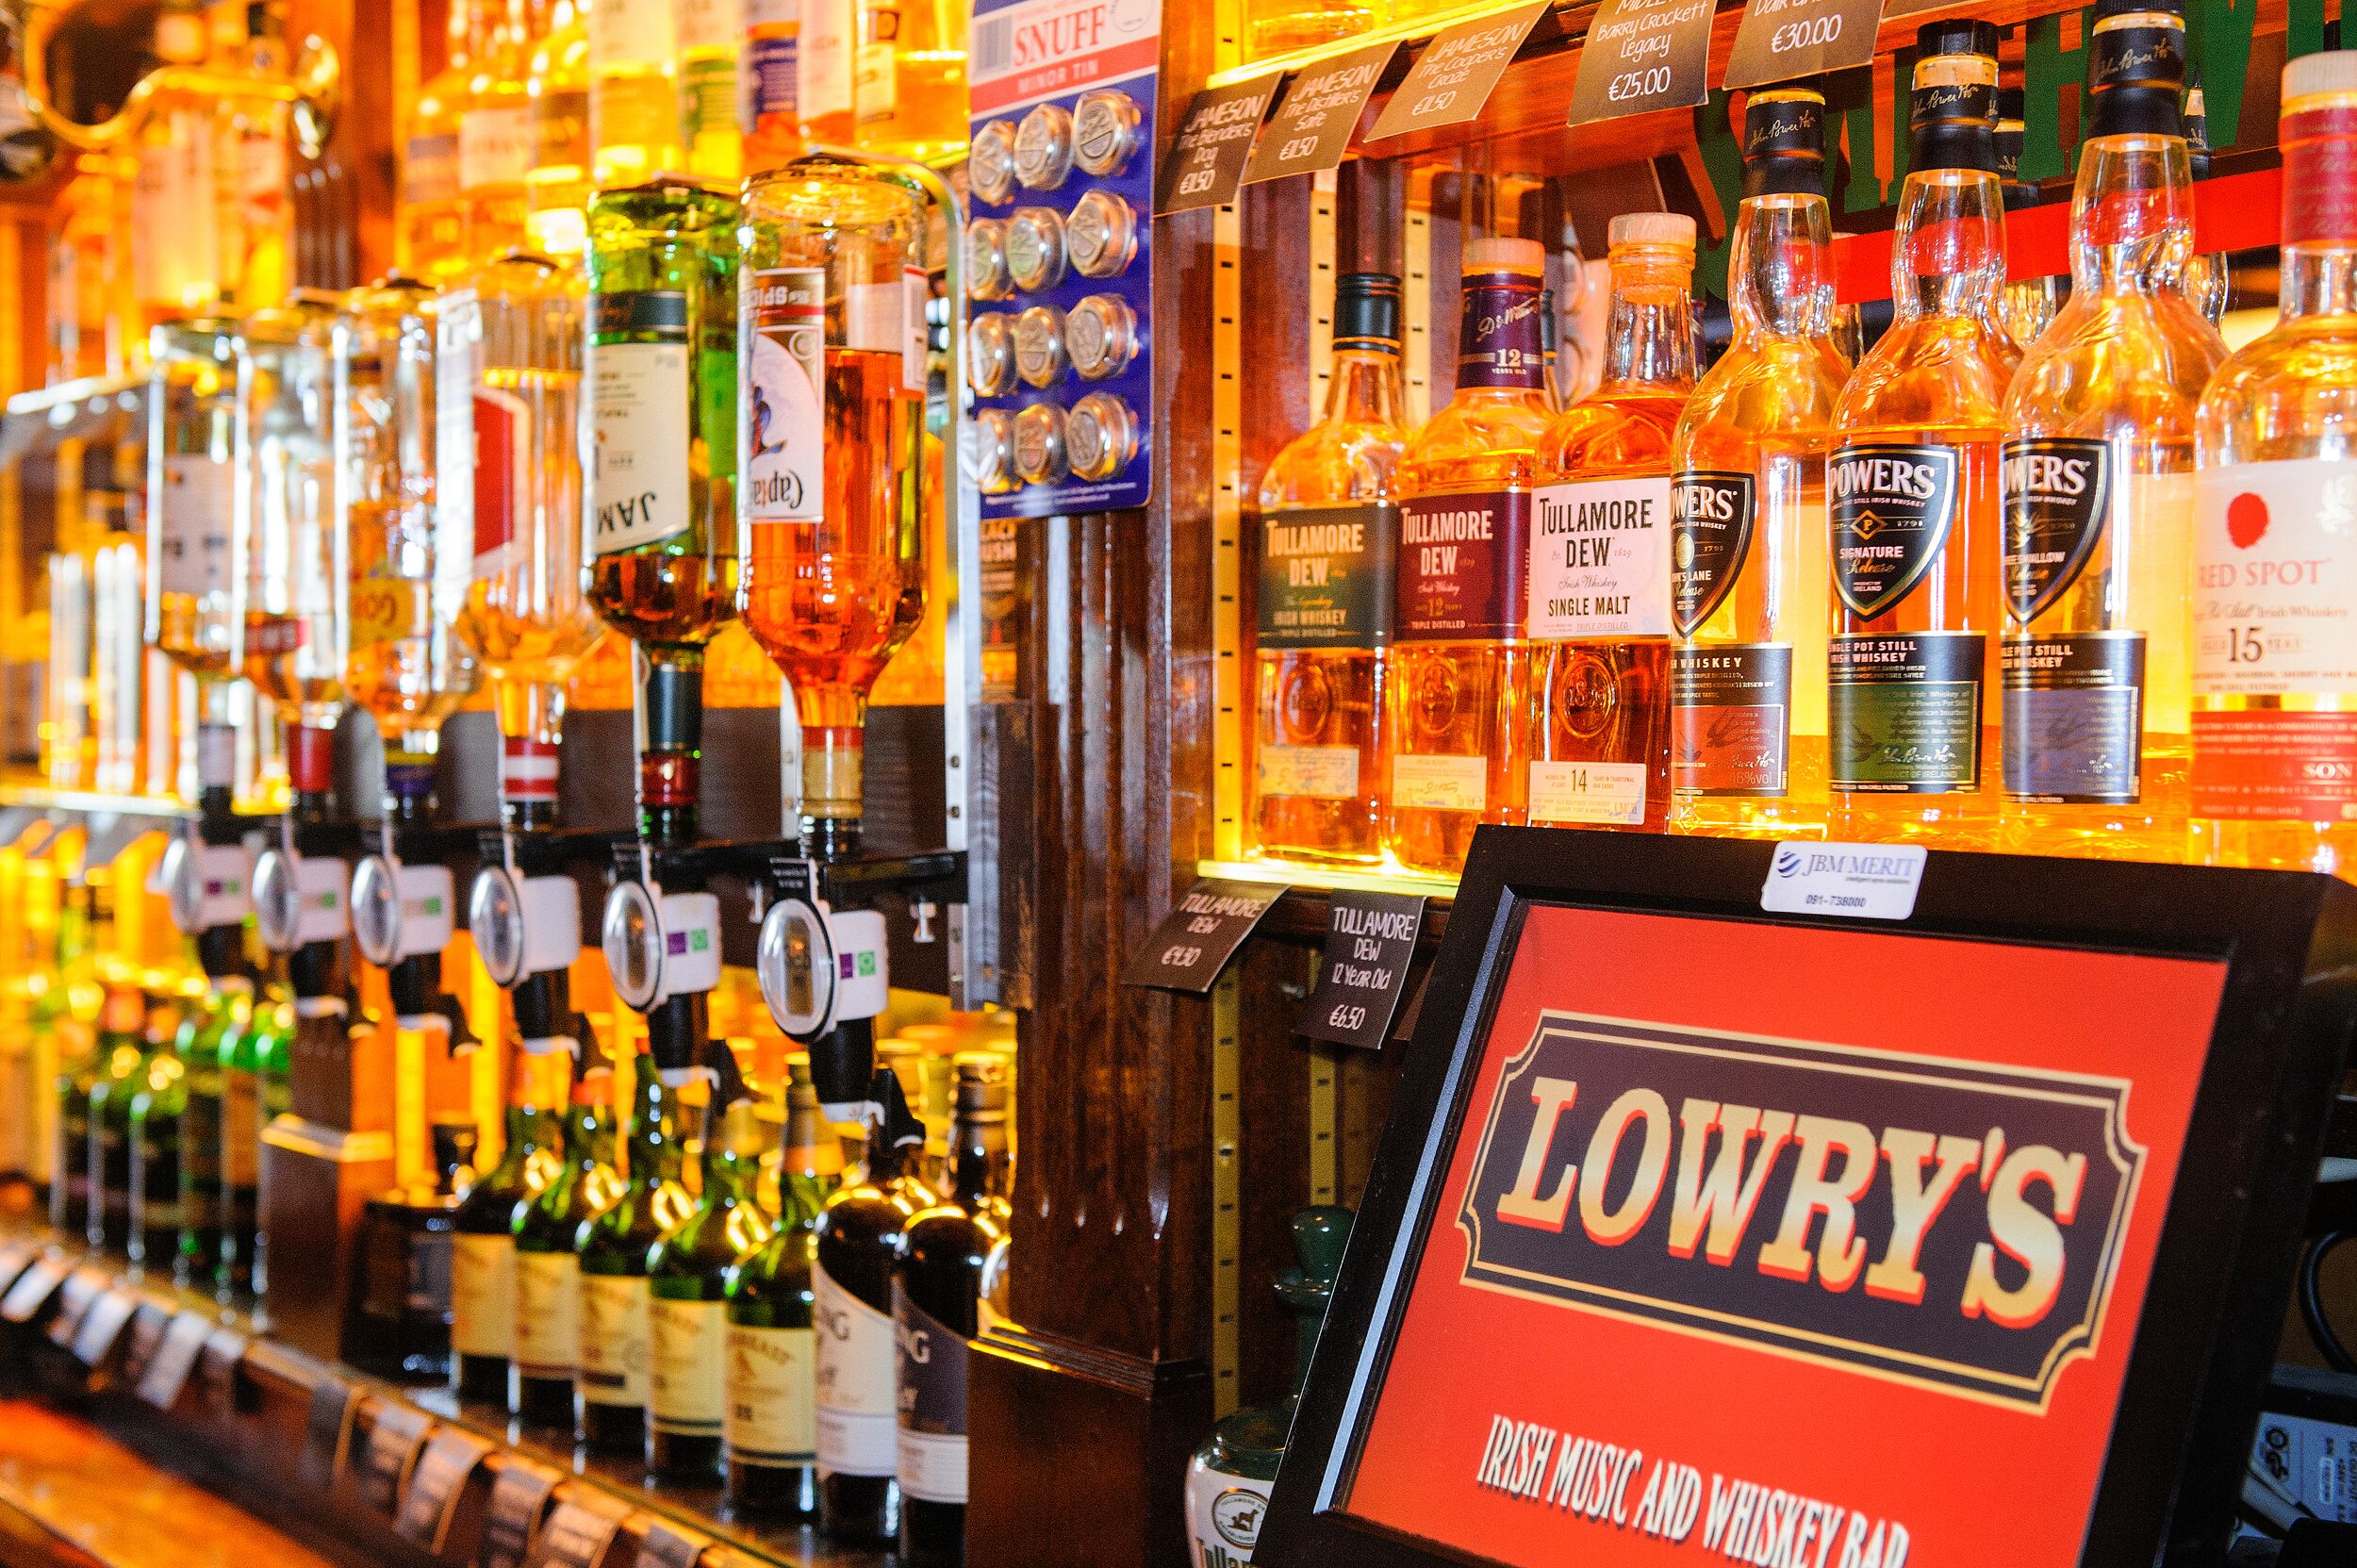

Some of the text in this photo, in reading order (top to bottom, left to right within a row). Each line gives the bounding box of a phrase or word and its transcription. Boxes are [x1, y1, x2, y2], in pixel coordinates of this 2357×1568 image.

[1014, 5, 1107, 67] SNUFF
[1426, 21, 1528, 62] JAMESON
[1771, 14, 1842, 53] €30.00
[1621, 34, 1672, 62] Legacy
[1072, 59, 1099, 80] TIN
[1291, 62, 1380, 102] JAMESON
[1607, 66, 1671, 102] €25.00
[1184, 93, 1266, 133] JAMESON
[1496, 349, 1522, 368] 12
[1829, 459, 1937, 502] POWERS
[1400, 507, 1493, 545] TULLAMORE
[1540, 498, 1654, 536] TULLAMORE
[1863, 520, 1873, 531] P
[1266, 520, 1364, 556] TULLAMORE
[1614, 548, 1632, 559] 1829
[1839, 546, 1904, 559] SIGNATURE
[1558, 574, 1618, 591] Irish Whiskey
[1688, 570, 1712, 582] LANE
[2245, 559, 2321, 586] SPOT
[1428, 597, 1443, 617] 12
[1548, 596, 1630, 617] SINGLE MALT
[1853, 641, 1918, 652] POT STILL
[2036, 645, 2073, 655] STILL
[2228, 626, 2263, 662] 15
[1680, 657, 1742, 668] WHISKEY
[1852, 652, 1907, 663] WHISKEY
[1572, 768, 1588, 792] 14
[2301, 763, 2353, 779] SON
[1803, 854, 1918, 877] JBM MERIT
[1180, 894, 1267, 919] TULLAMORE
[1186, 916, 1222, 934] DEW
[1333, 907, 1416, 942] TULLAMORE
[1354, 938, 1382, 962] DEW
[1496, 1075, 2087, 1330] LOWRY'S
[1475, 1414, 1557, 1499] IRISH
[1545, 1433, 1642, 1527] MUSIC
[1632, 1458, 1703, 1543] AND
[1703, 1473, 1846, 1568] WHISKEY
